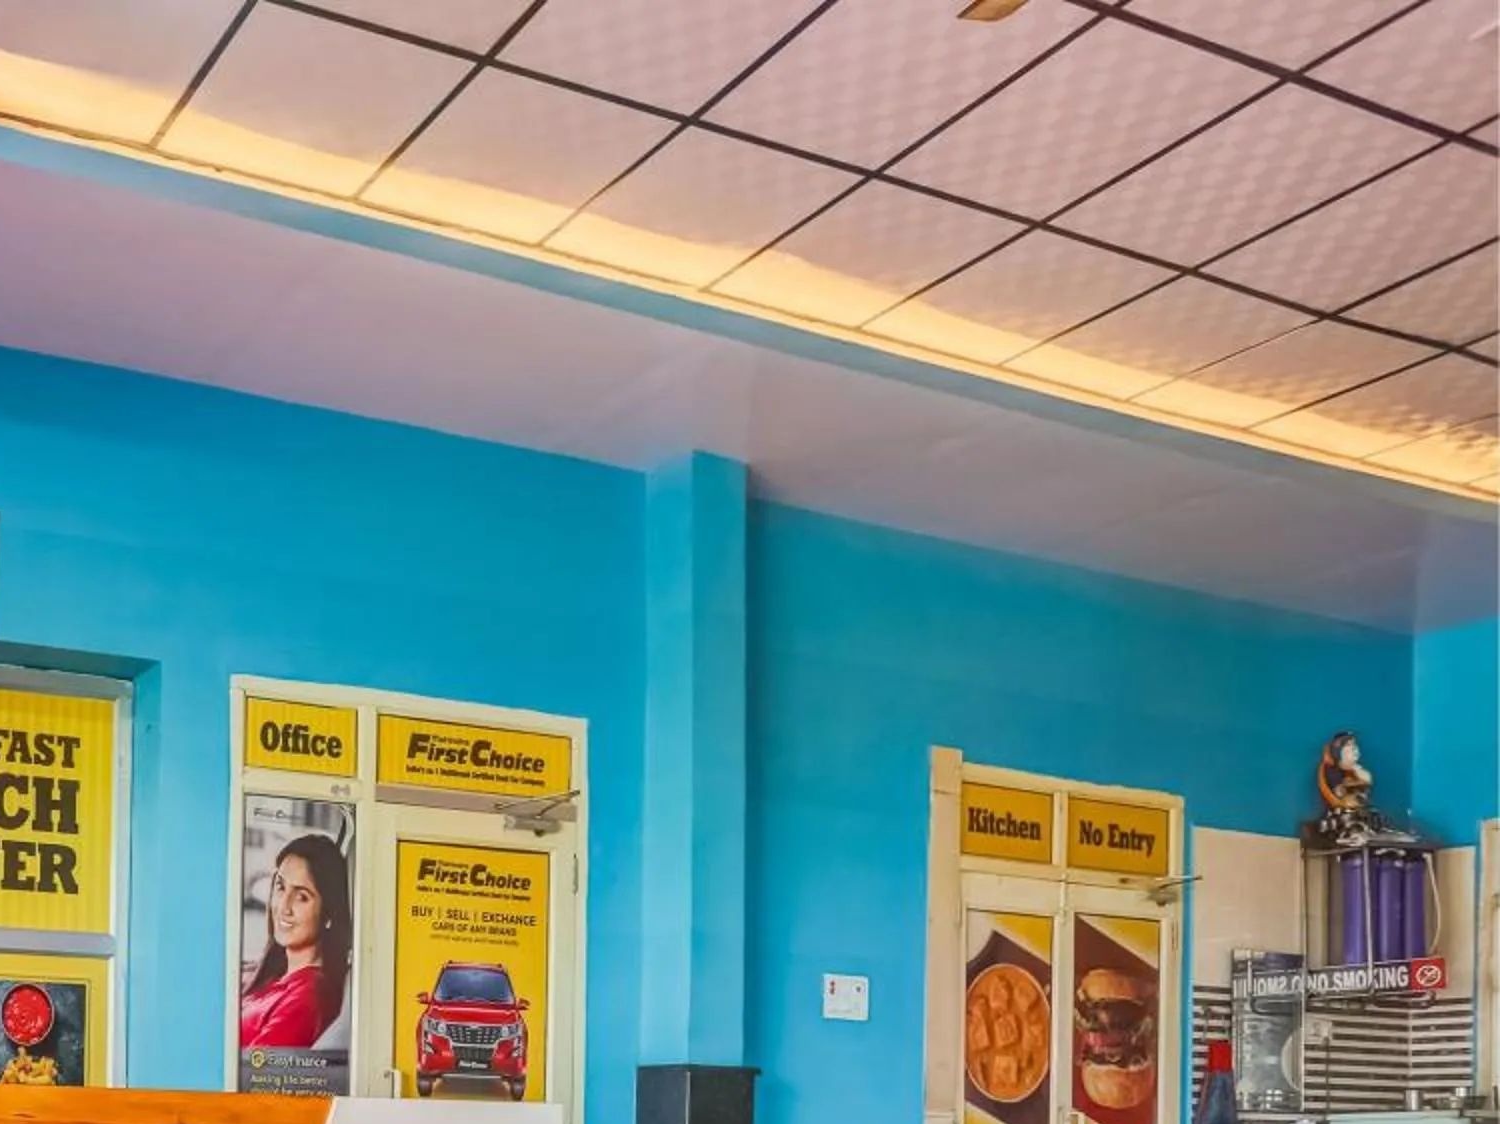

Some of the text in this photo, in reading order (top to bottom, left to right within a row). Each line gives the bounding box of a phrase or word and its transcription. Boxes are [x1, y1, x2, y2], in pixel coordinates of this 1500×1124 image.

[260, 721, 343, 758] Office
[968, 807, 1041, 840] Kitchen
[1079, 820, 1156, 858] No Entry
[411, 905, 537, 927] BUY SELL EXCHANGE
[1307, 974, 1330, 992] NO
[1334, 965, 1409, 992] SMOKING
